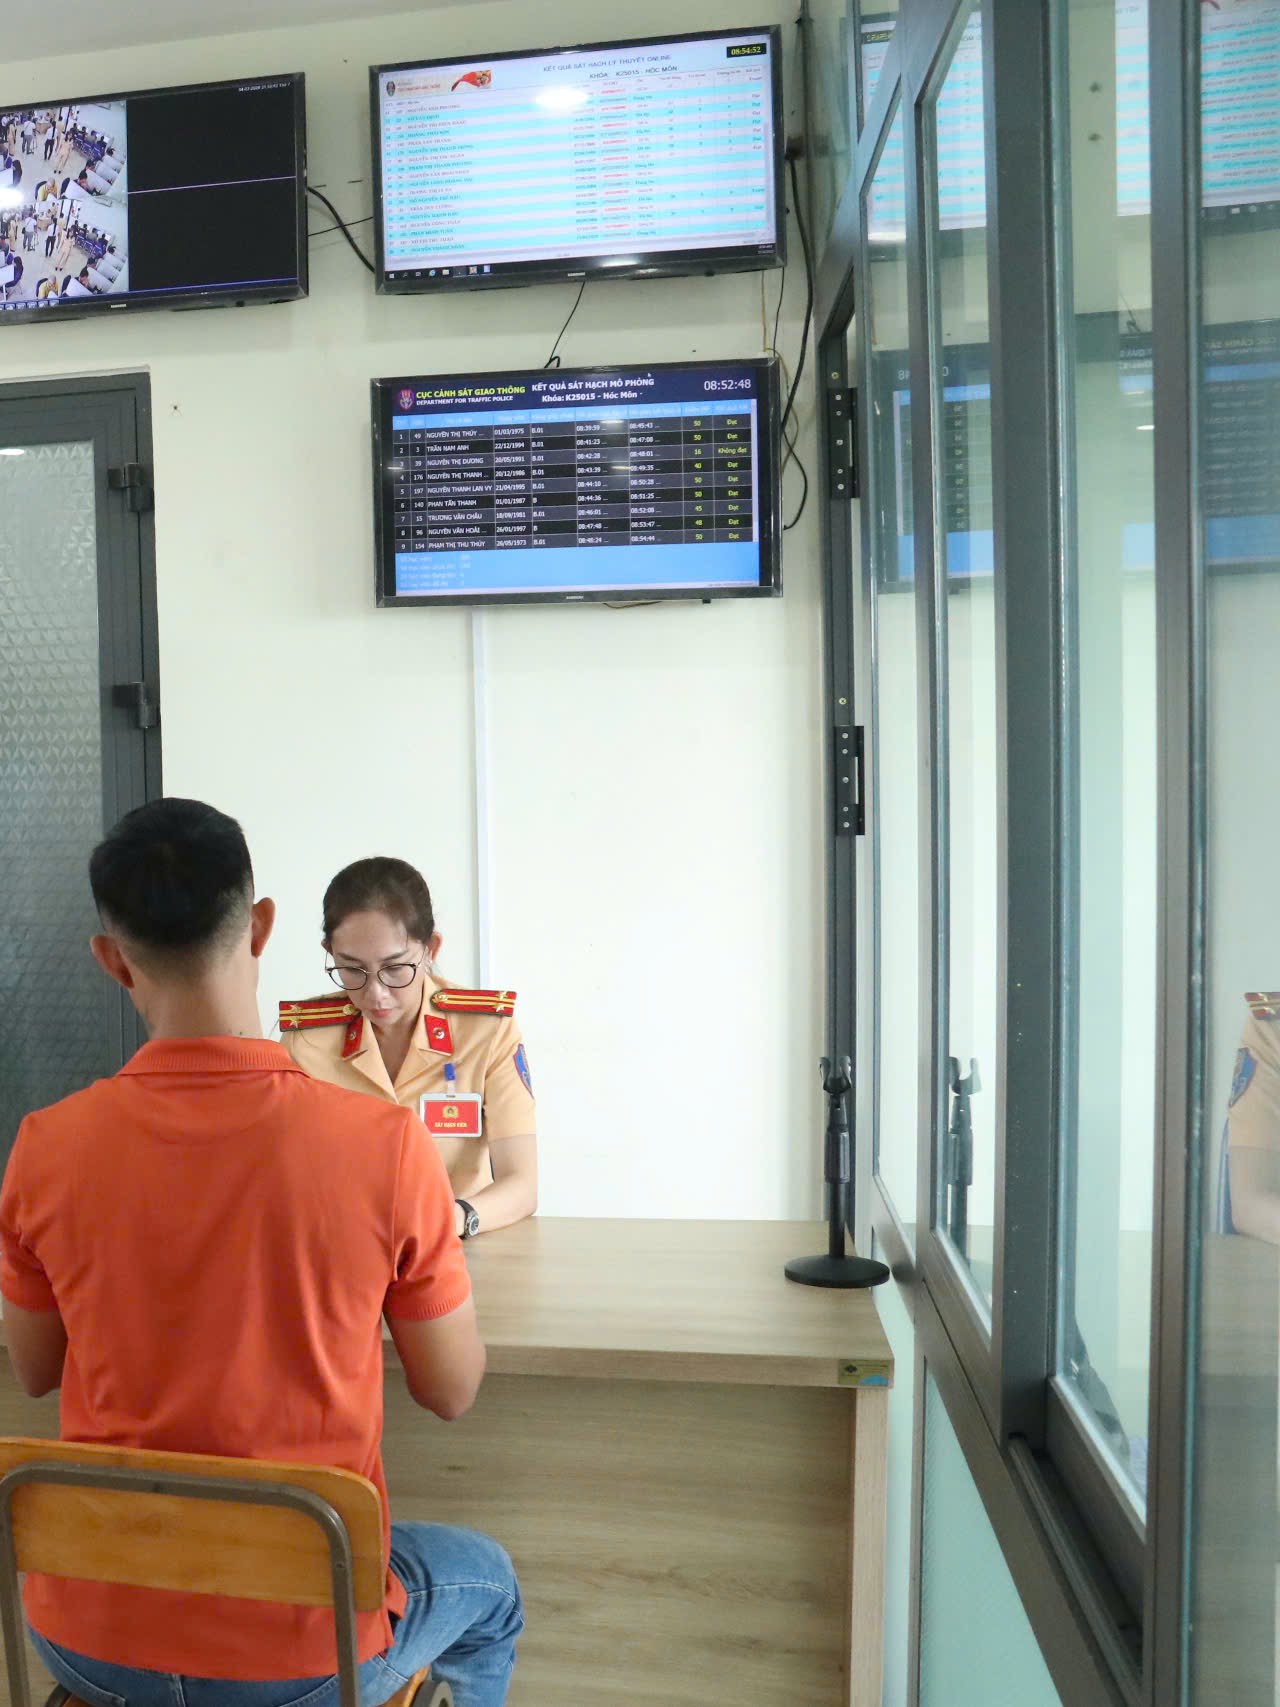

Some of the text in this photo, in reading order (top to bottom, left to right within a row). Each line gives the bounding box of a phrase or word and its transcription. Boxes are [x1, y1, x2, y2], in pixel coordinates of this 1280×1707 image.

[731, 47, 761, 55] 08:54:52
[532, 382, 547, 391] KẾT
[549, 381, 566, 391] QUẢ
[568, 380, 583, 389] SÁT
[585, 380, 607, 389] HẠCH
[610, 379, 623, 387] MÔ
[704, 379, 751, 390] 08:52:48
[434, 389, 455, 397] CẢNH
[458, 388, 473, 396] SÁT
[497, 385, 525, 394] THÔNG
[542, 394, 564, 402] Khóa:
[566, 393, 595, 401] K25015
[603, 391, 618, 399] Hóc
